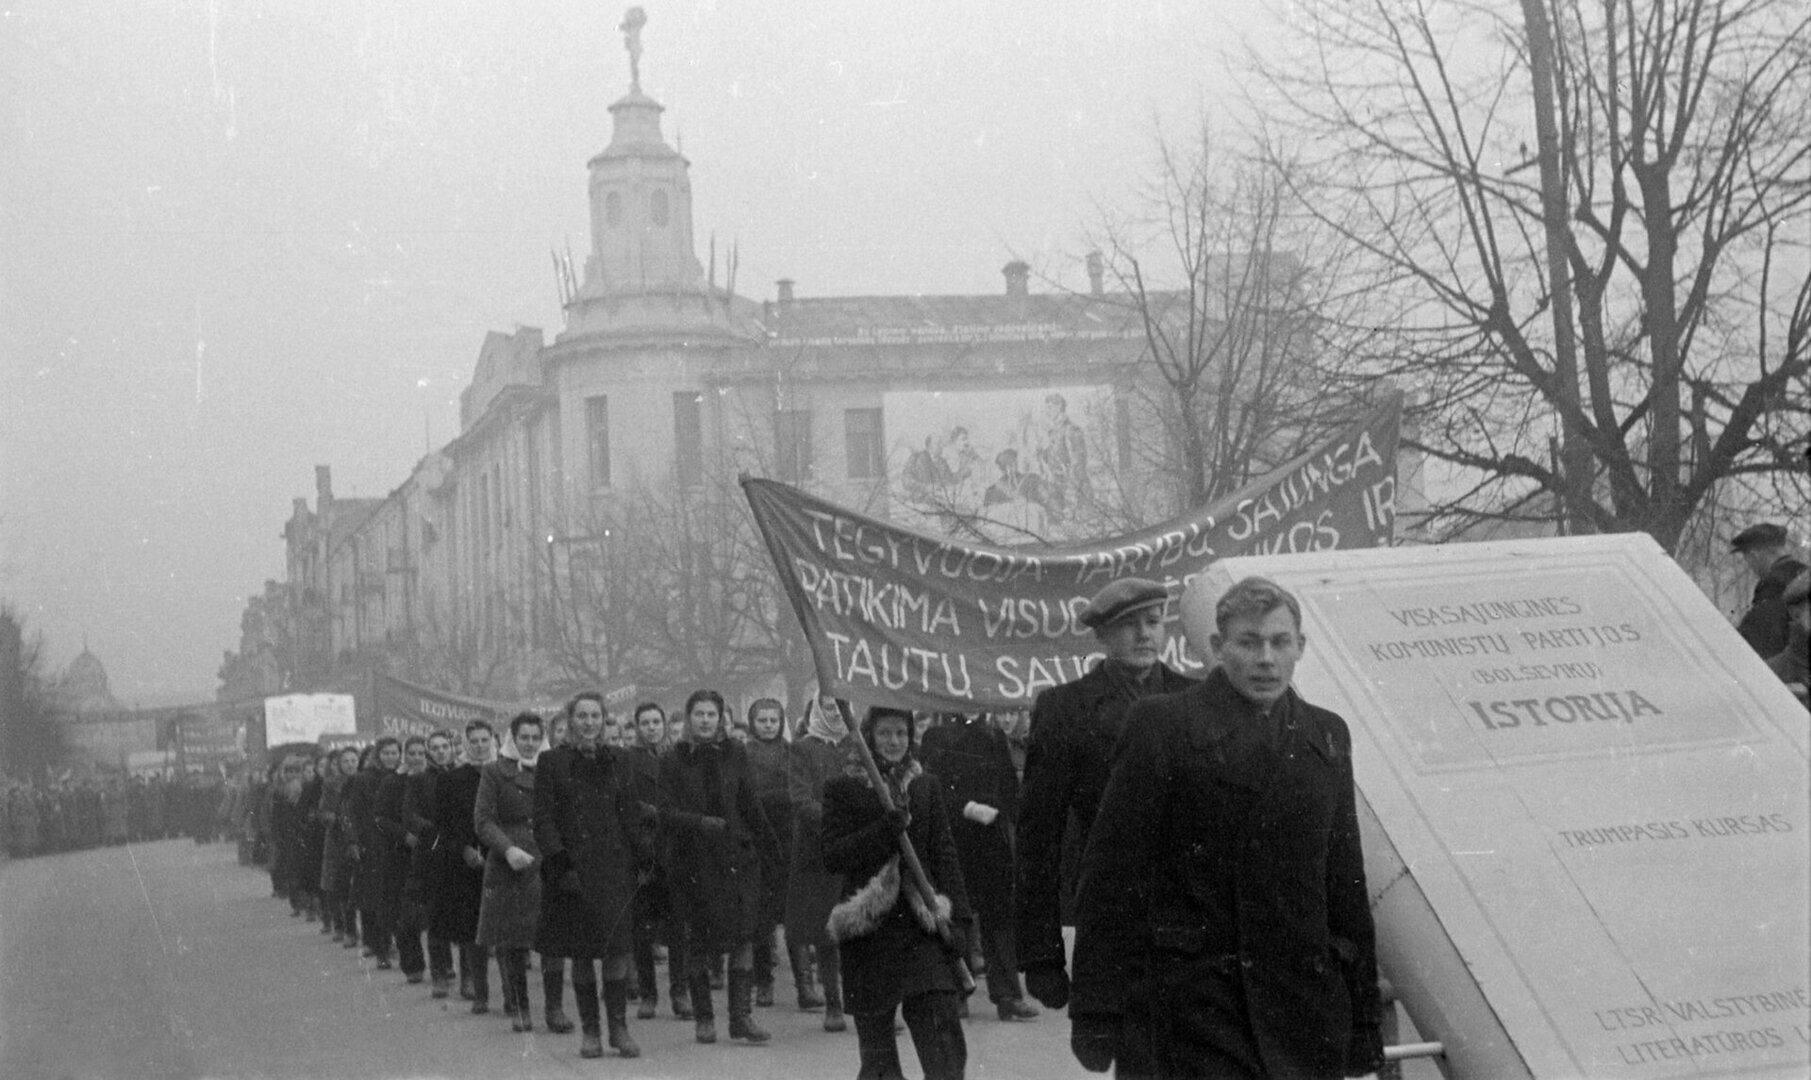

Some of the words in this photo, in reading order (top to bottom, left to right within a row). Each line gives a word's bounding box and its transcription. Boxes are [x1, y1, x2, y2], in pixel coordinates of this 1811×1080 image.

[796, 557, 961, 636] PATIKIMA
[1362, 476, 1397, 531] IR
[801, 508, 1042, 583] TEGYVUOJA
[1065, 515, 1216, 584] TARYBŲ
[1368, 633, 1511, 661] KOMUNISTŲ
[1521, 624, 1642, 650] PARTIJOS
[825, 630, 974, 700] TAUTŲ
[1468, 690, 1665, 730] ISTORIJA
[1557, 821, 1690, 848] TRUMPASIS
[1691, 813, 1794, 838] KURSAS
[1595, 1007, 1662, 1031] LTSR
